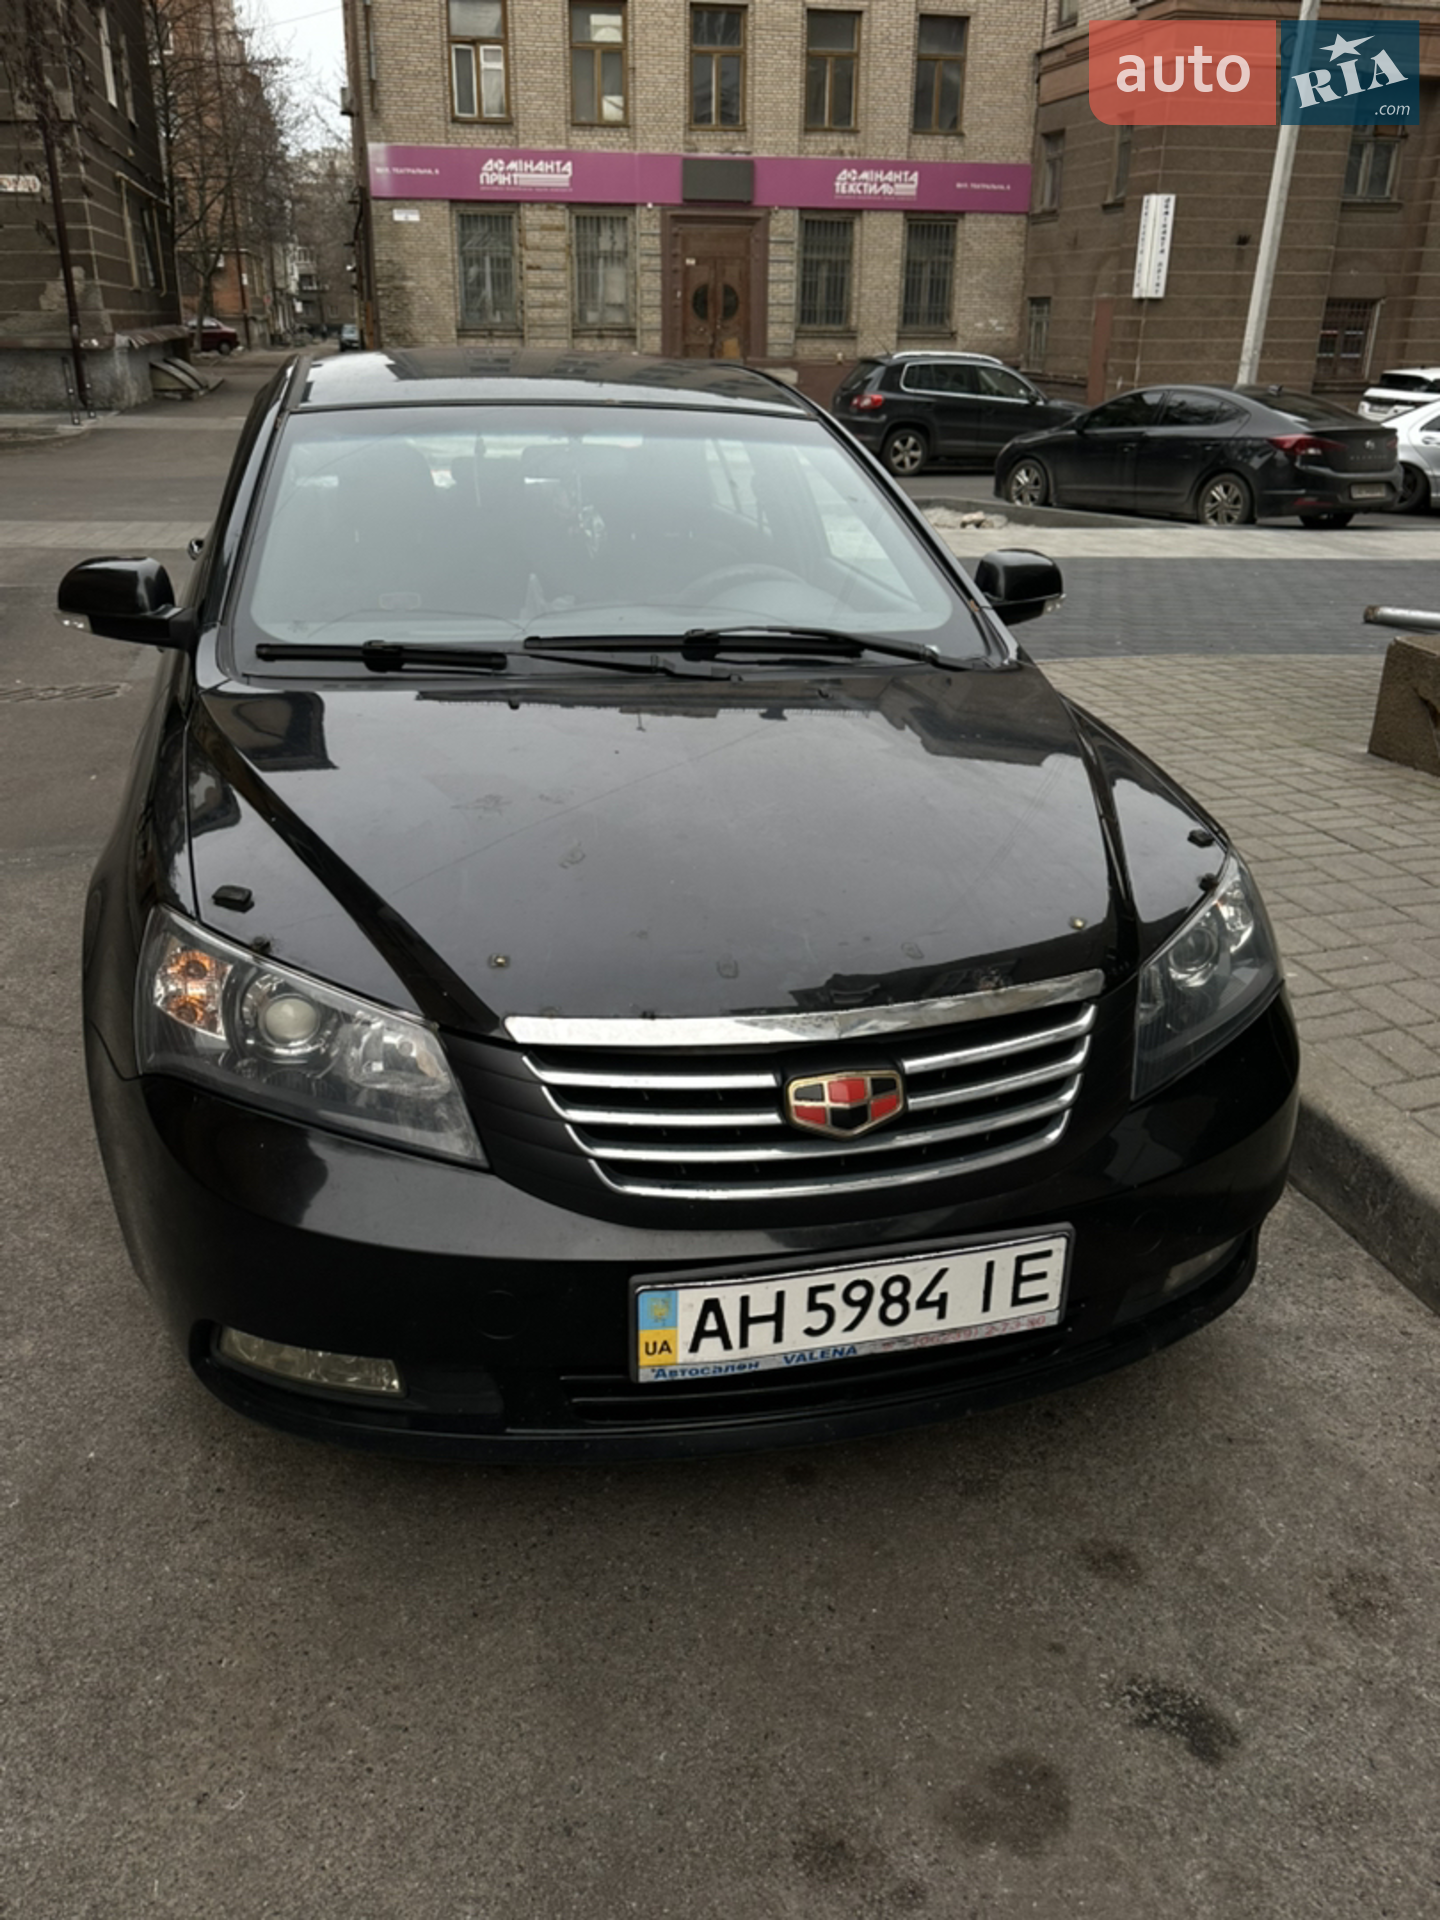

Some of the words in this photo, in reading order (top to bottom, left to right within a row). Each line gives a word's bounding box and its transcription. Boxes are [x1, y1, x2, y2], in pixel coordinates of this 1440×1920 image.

[688, 1290, 785, 1353] AH
[802, 1266, 949, 1338] 5984
[981, 1249, 1054, 1313] IE
[644, 1340, 673, 1356] UA
[783, 1344, 859, 1366] VALENA
